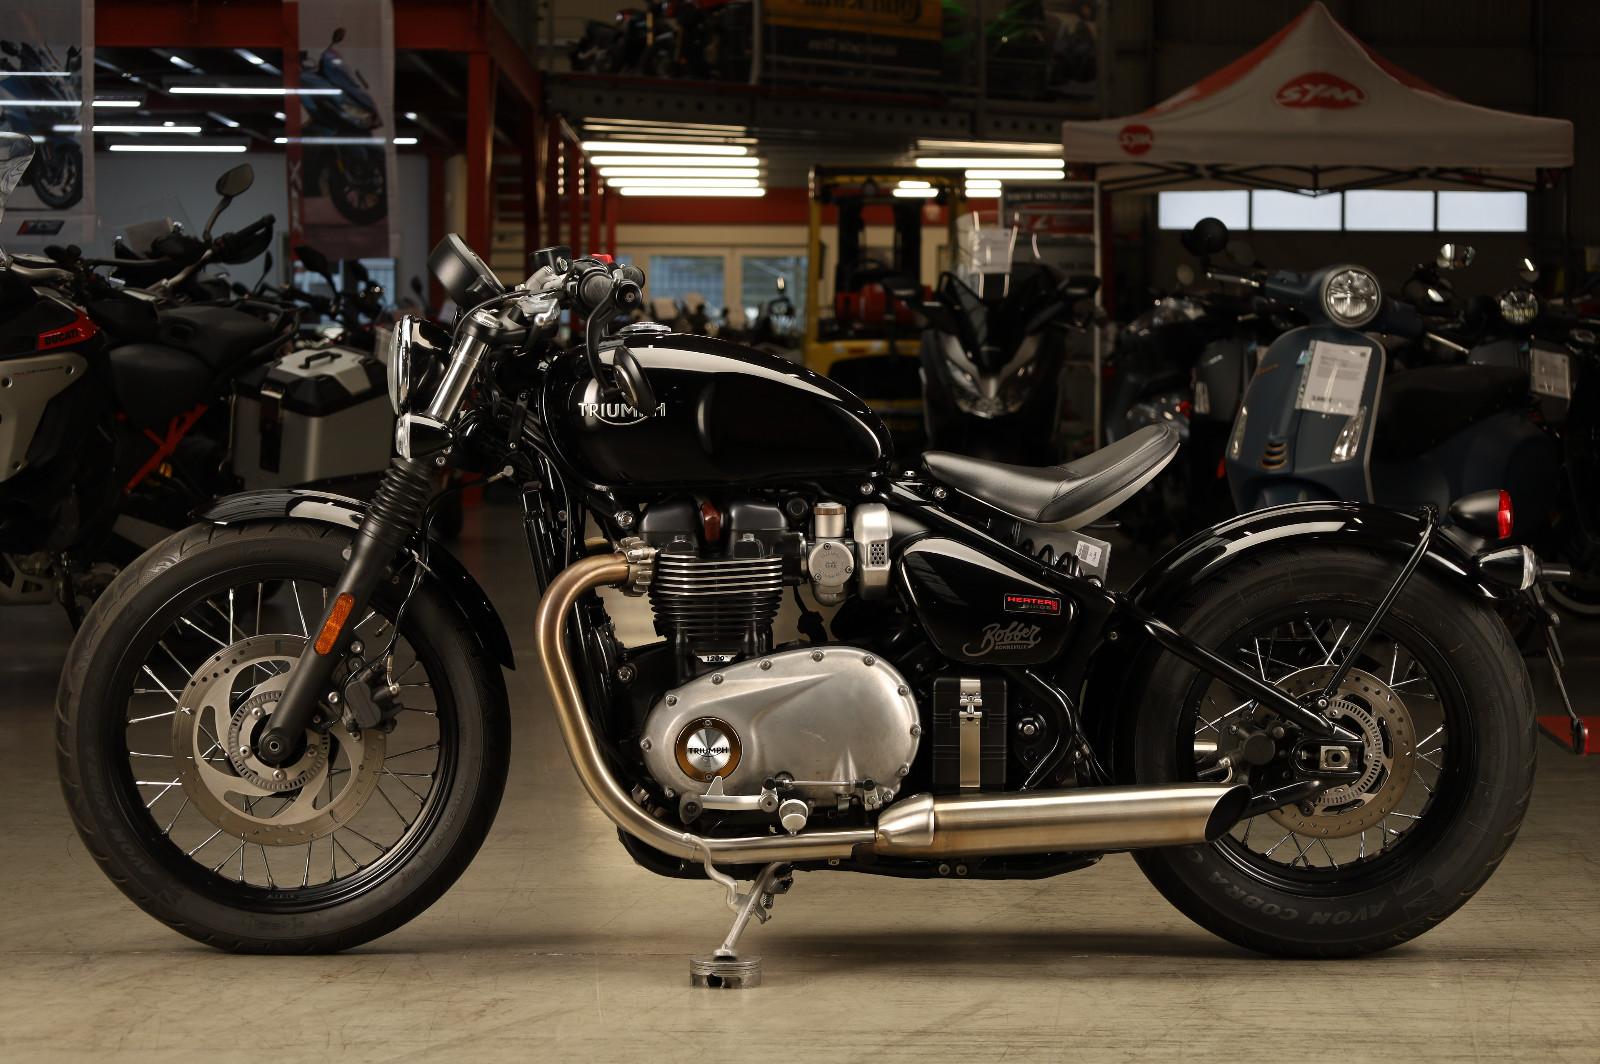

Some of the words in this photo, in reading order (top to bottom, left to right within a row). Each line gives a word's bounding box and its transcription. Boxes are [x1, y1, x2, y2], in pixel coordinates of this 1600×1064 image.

[1277, 82, 1364, 104] SYM
[577, 402, 666, 418] TRIUMH
[962, 620, 1042, 656] Bobber
[688, 746, 728, 754] TRIUMPH
[1207, 870, 1300, 922] COBRA
[1306, 899, 1389, 926] AVON
